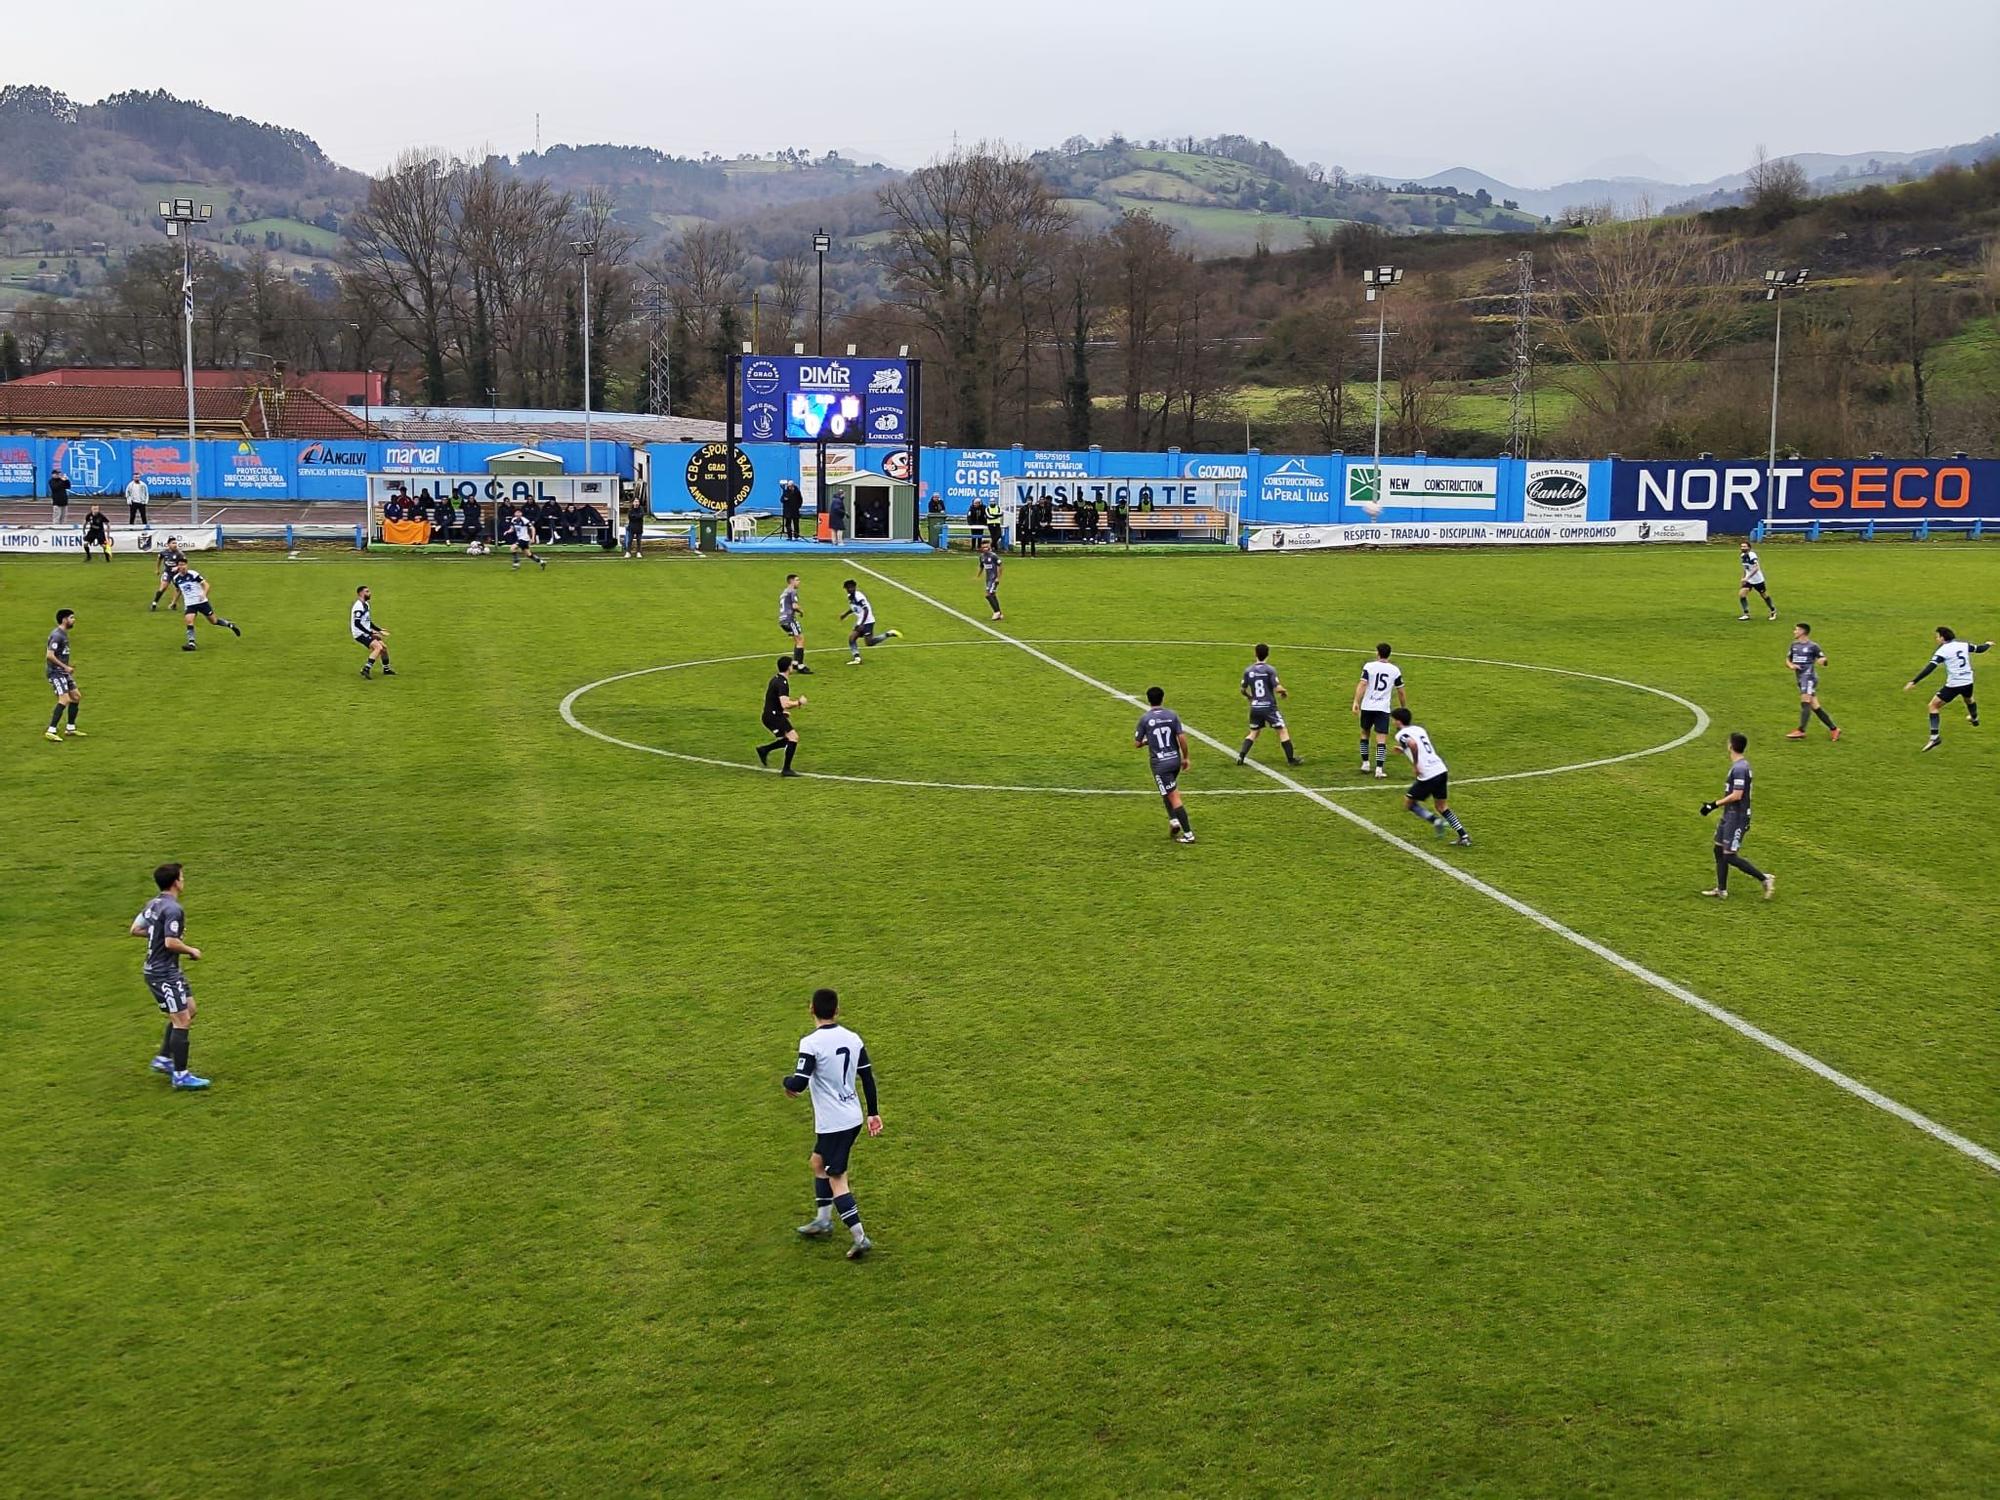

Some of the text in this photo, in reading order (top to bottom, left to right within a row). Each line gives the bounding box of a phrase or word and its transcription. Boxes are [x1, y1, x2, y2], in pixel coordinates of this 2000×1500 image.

[322, 447, 367, 466] ANGILVI
[386, 445, 440, 464] marval
[962, 451, 977, 459] BAR
[687, 456, 702, 482] CBC
[736, 454, 753, 480] BAR
[956, 460, 1000, 468] RESTAURANTE
[1024, 461, 1045, 470] PUENTE
[1045, 462, 1054, 470] DE
[955, 468, 1000, 486] CASA
[1198, 465, 1248, 479] GOZNATRA
[1530, 469, 1583, 480] CRISTALERIA
[146, 476, 192, 486] 985753328
[1263, 477, 1325, 487] CONSTRUCCIONES
[1389, 478, 1484, 492] NEW CONSTRUCTION
[434, 481, 557, 501] LOCAL
[947, 487, 977, 497] COMIDA
[2, 535, 39, 547] LIMPIO
[1344, 528, 1381, 541] RESPETO
[1391, 528, 1430, 539] TRABAJO
[1440, 528, 1486, 539] DISCIPLINA
[1496, 526, 1551, 539] IMPLICACIÓN
[1559, 526, 1617, 538] COMPROMISO
[1254, 679, 1265, 698] 8
[1373, 672, 1389, 692] 15
[1152, 725, 1172, 749] 17
[835, 1046, 850, 1085] 7
